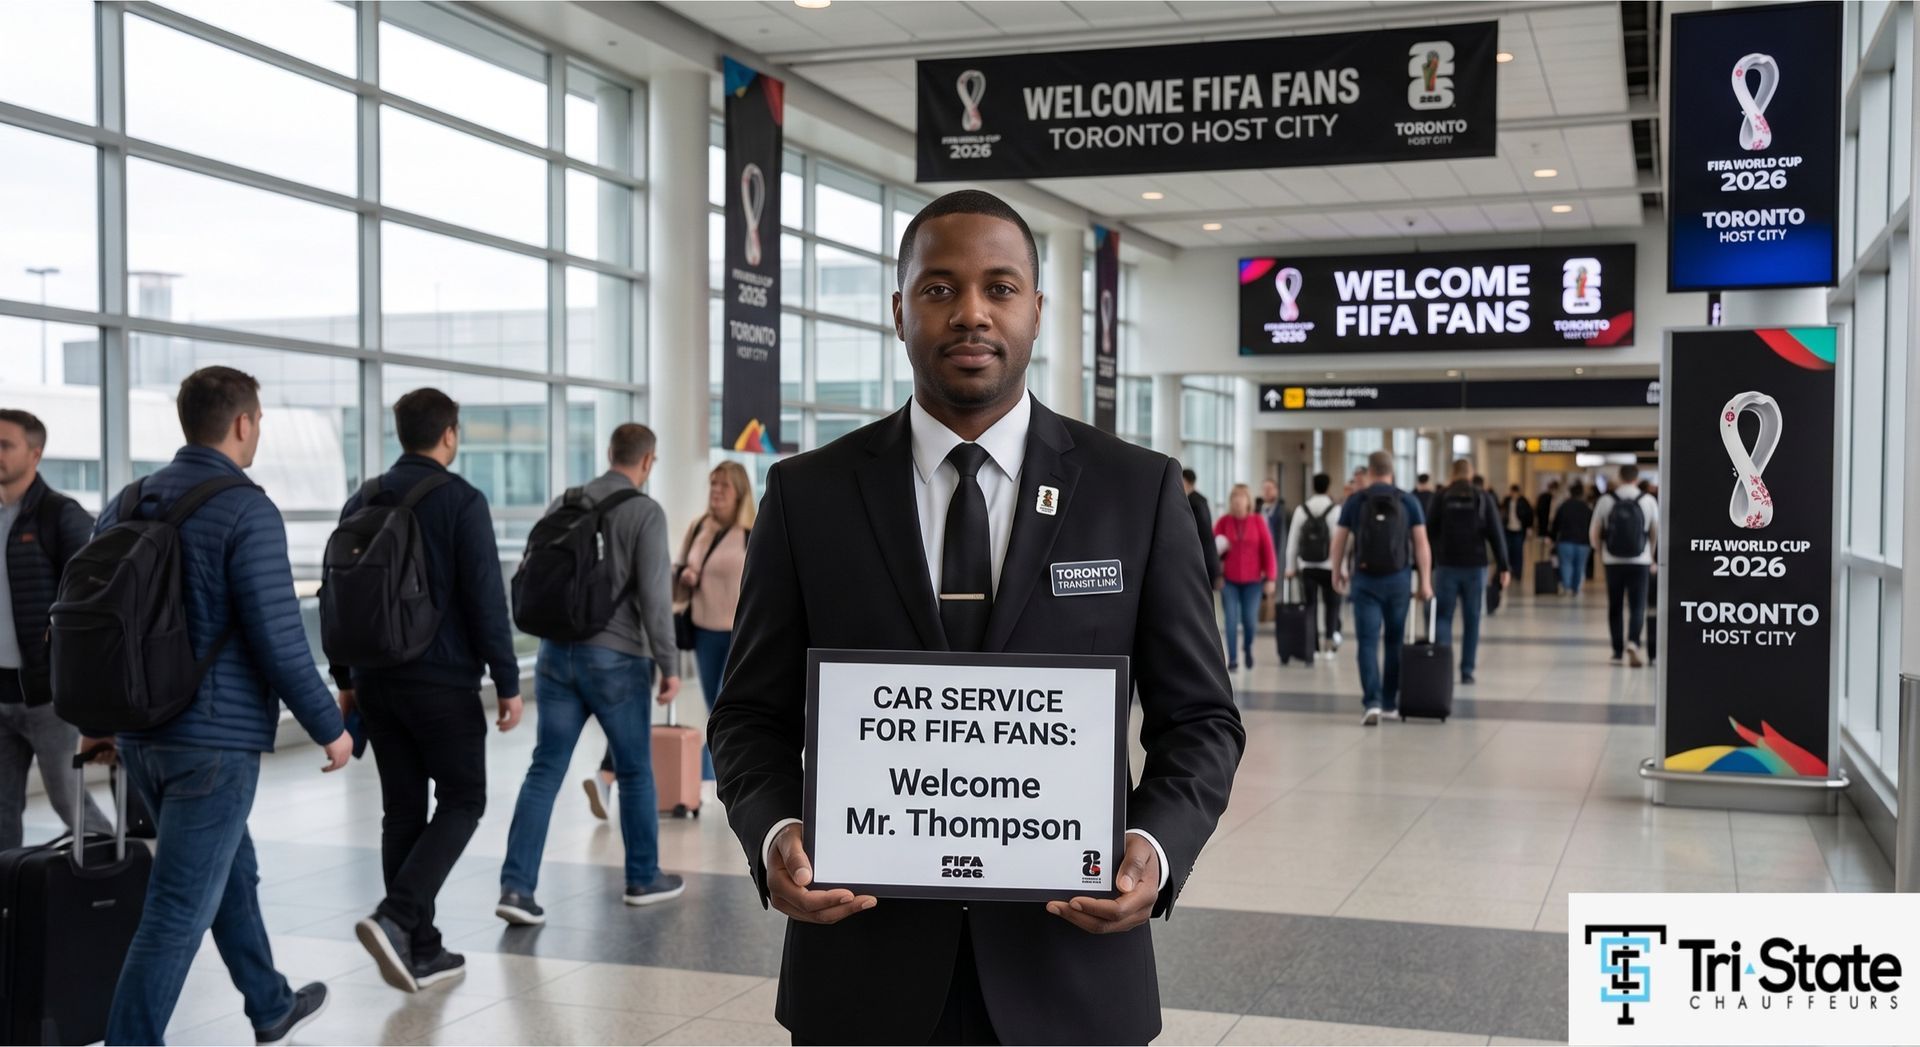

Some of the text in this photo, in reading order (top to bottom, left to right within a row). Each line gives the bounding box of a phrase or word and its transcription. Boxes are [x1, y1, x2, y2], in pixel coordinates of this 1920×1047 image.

[1023, 67, 1360, 121] WELCOME FIFA FANS
[1048, 113, 1339, 150] TORONTO HOST CITY
[1394, 119, 1468, 136] TORONTO
[949, 143, 992, 159] 2026
[1707, 156, 1803, 171] FIFA WORLD CUP
[1720, 169, 1788, 192] 2026
[1702, 207, 1806, 229] TORONTO
[1719, 229, 1787, 243] HOST CITY
[1333, 264, 1531, 302] WELCOME
[1336, 299, 1531, 337] FIFA FANS
[1553, 319, 1610, 331] TORONTO
[730, 320, 776, 347] TORONTO
[1690, 539, 1811, 553] FIFA WORLD CUP
[1056, 566, 1117, 580] TORONTO
[1712, 555, 1787, 578] 2026
[1058, 578, 1118, 589] TRANSIT LINK
[1680, 601, 1820, 626] TORONTO
[1702, 628, 1797, 646] HOST CITY
[874, 686, 1062, 712] CAR SERVICE
[860, 718, 1076, 745] FOR FIFA FANS:
[889, 768, 1040, 798] Welcome
[847, 808, 1080, 845] Mr. Thompson
[942, 856, 983, 867] FIFA
[942, 868, 982, 878] 2026
